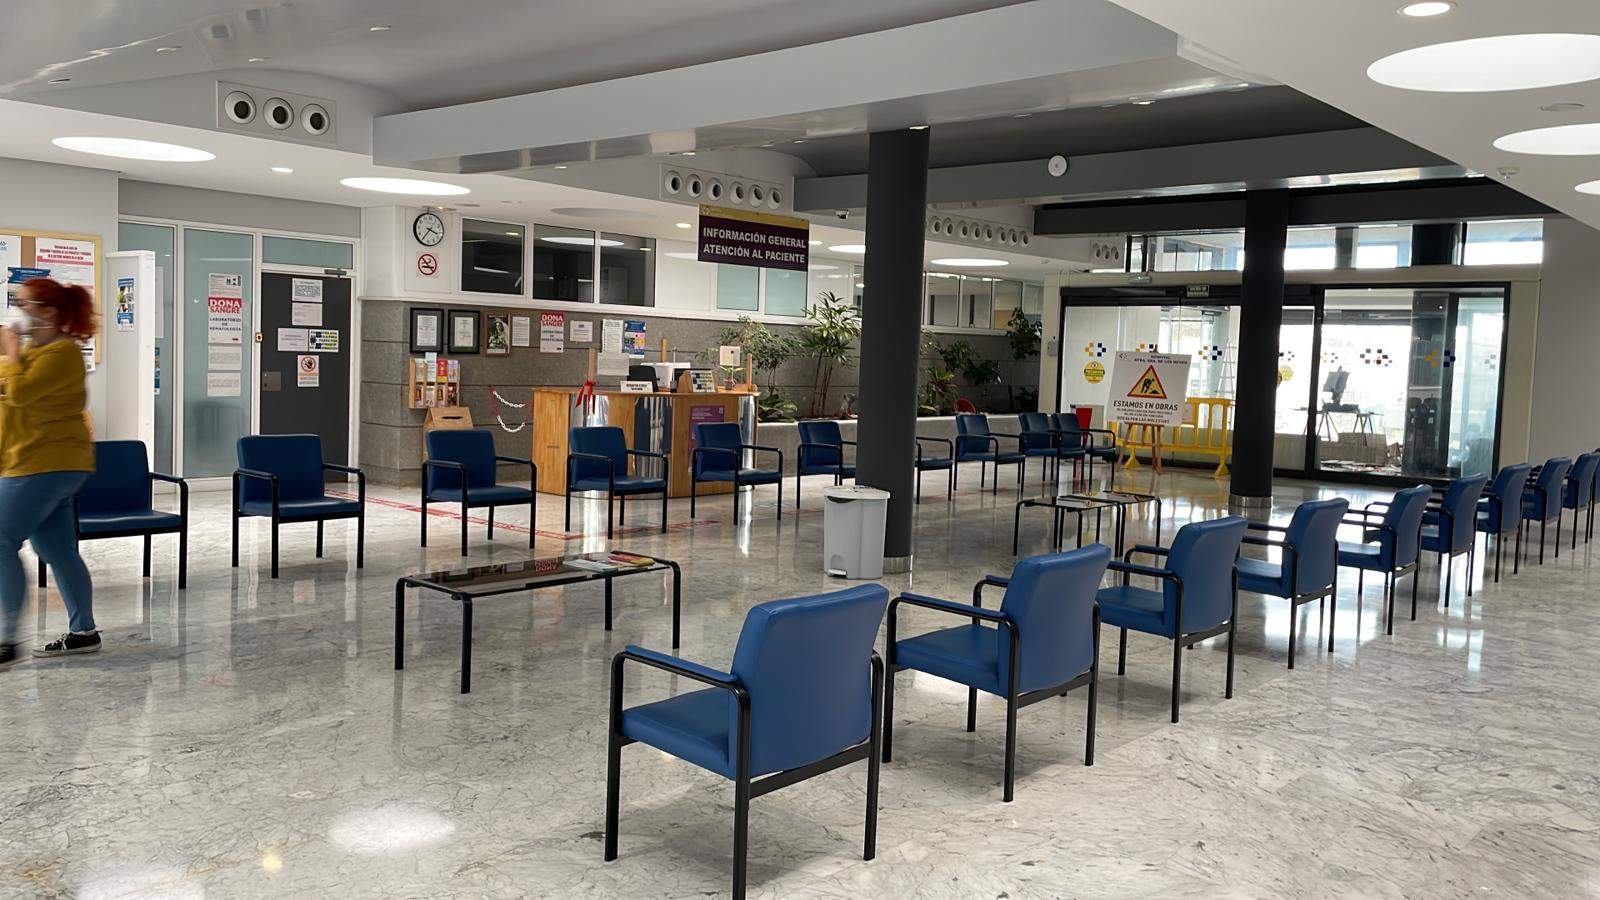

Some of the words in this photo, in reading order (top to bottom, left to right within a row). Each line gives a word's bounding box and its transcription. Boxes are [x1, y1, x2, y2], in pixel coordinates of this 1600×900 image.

[703, 227, 766, 244] INFORMACIÓN
[768, 235, 807, 249] GENERAL
[703, 243, 750, 258] ATENCIÓN
[752, 249, 764, 259] AL
[765, 250, 805, 263] PACIENTE
[209, 299, 240, 308] DONA
[209, 306, 241, 314] SANGRE
[1113, 400, 1143, 409] ESTAMOS
[1155, 403, 1179, 411] OBRAS
